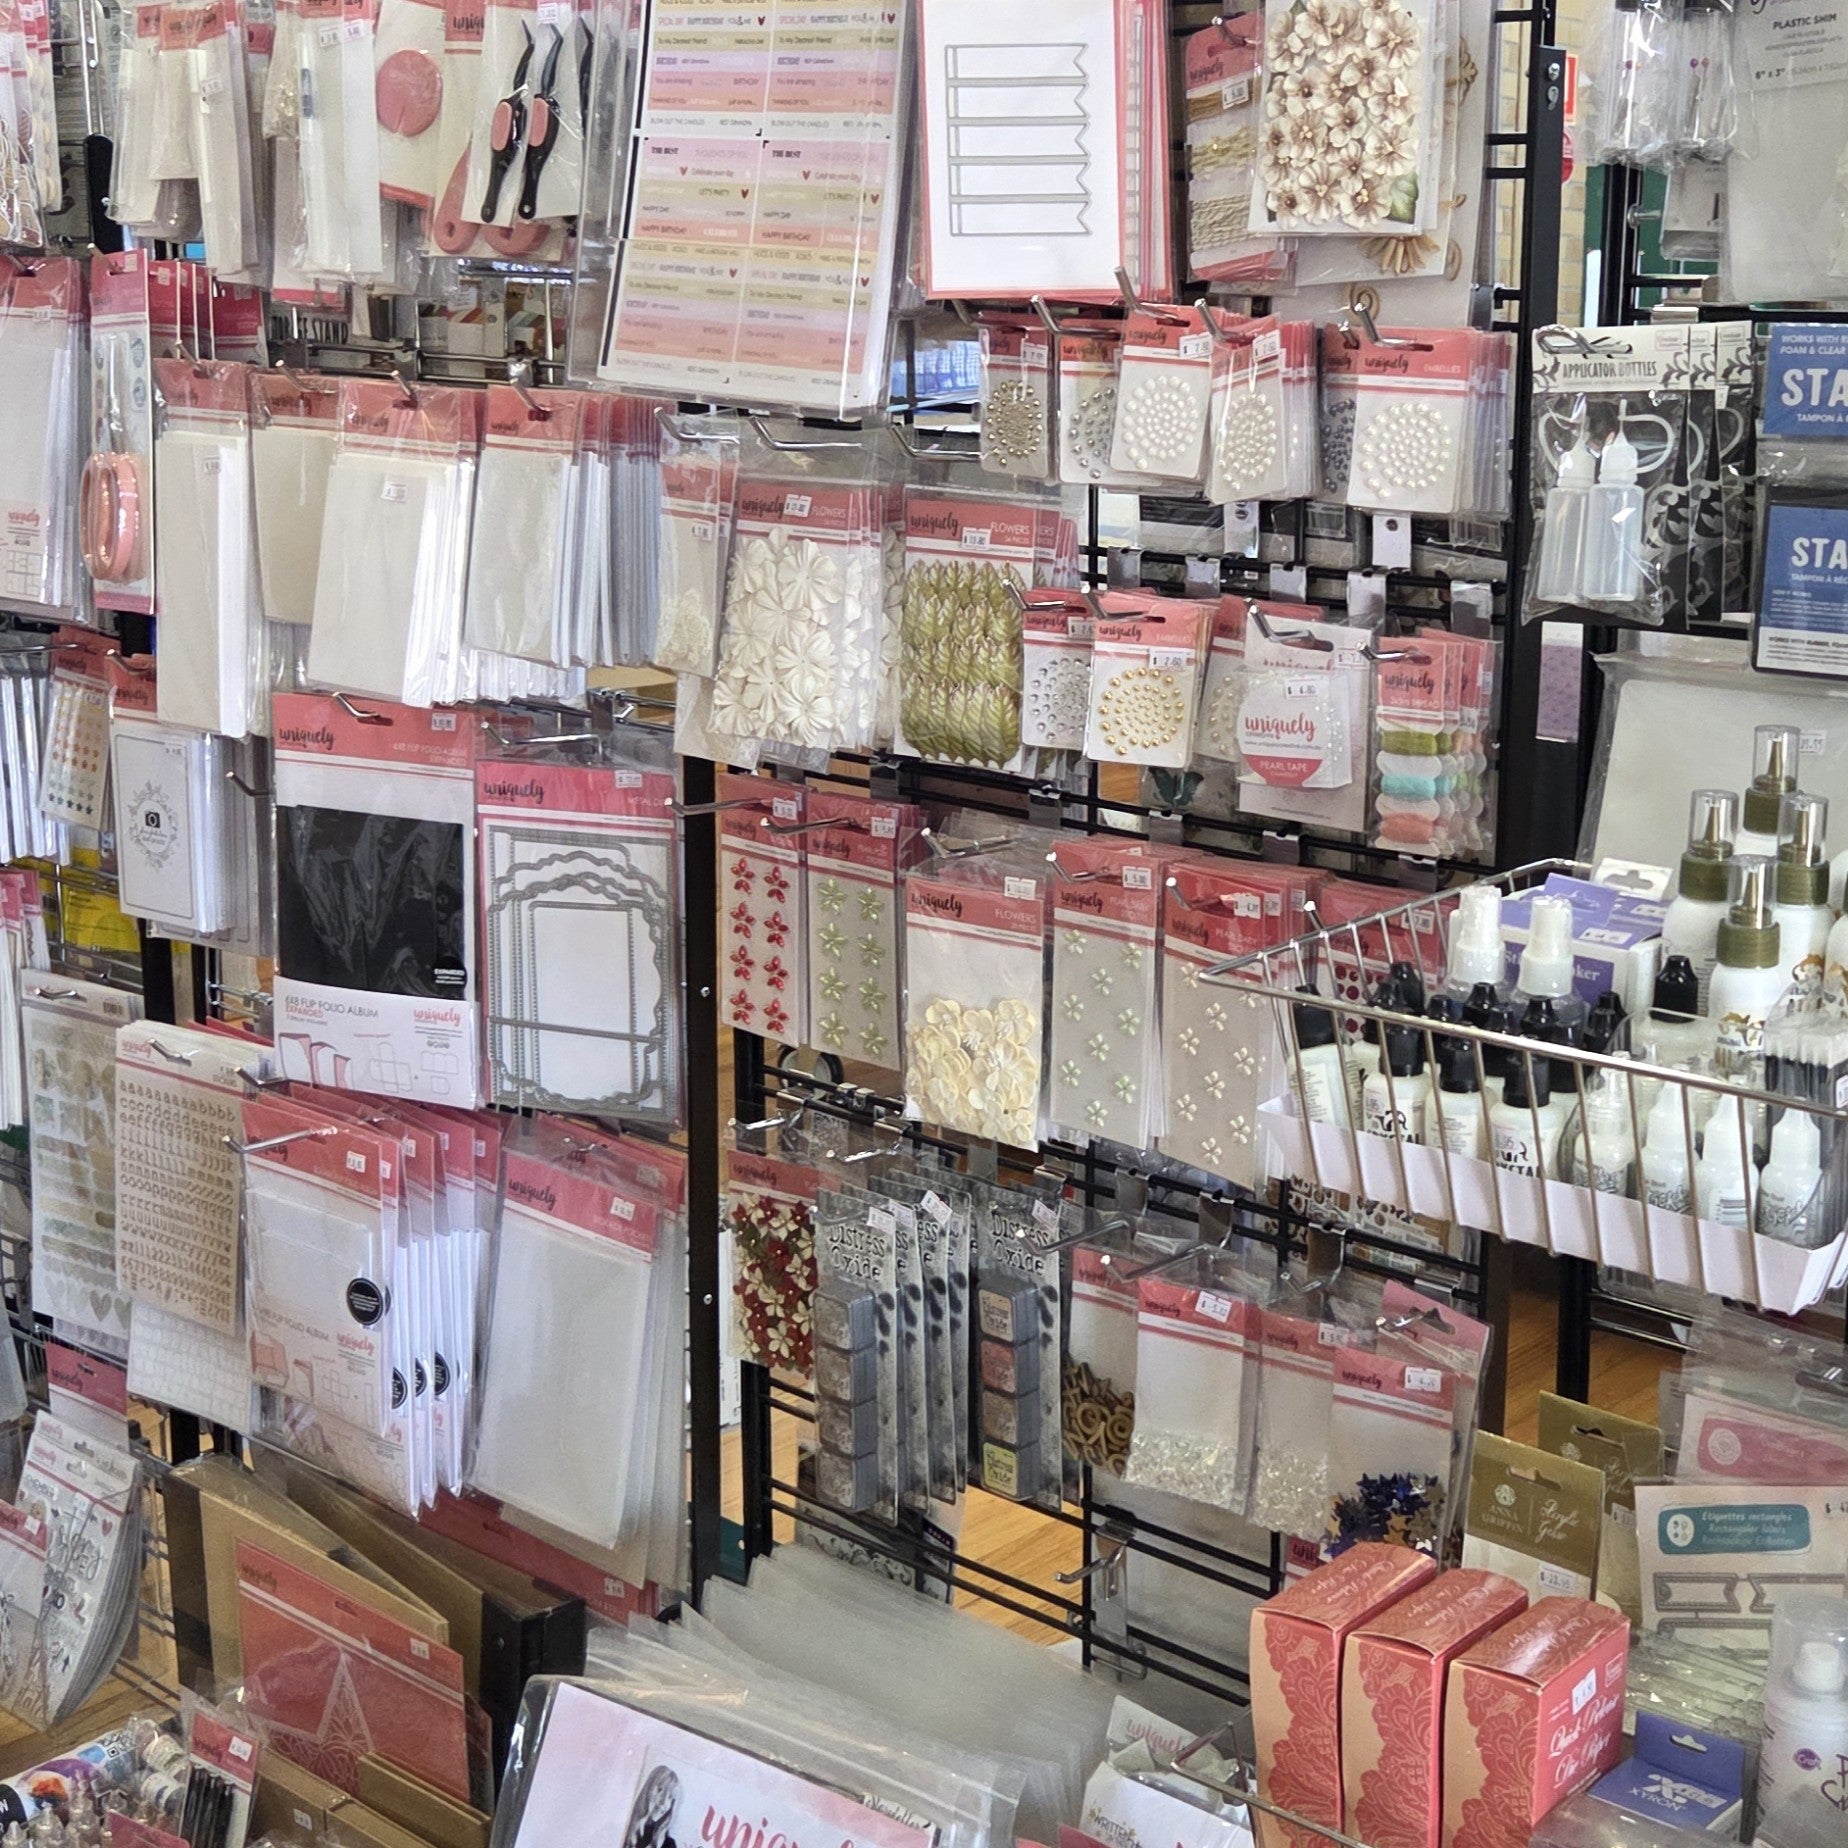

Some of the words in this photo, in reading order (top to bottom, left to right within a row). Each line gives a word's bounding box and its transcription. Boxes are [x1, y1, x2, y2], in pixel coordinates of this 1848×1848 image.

[1773, 16, 1811, 30] PLASTIC
[1814, 13, 1837, 24] SHIM
[663, 147, 678, 155] BEST
[785, 150, 801, 158] BEST
[1781, 335, 1814, 343] WORKS
[1816, 335, 1840, 343] WITH
[1780, 346, 1807, 355] FOAM
[1809, 346, 1816, 355] &
[1817, 346, 1847, 355] CLEAR
[1563, 362, 1616, 378] APPLICATOR
[1618, 361, 1657, 377] BOTTLES
[1781, 368, 1848, 407] STA
[1797, 413, 1835, 422] TAMPON
[910, 512, 959, 536] uniquely
[990, 522, 1030, 535] FLOWERS
[1791, 537, 1848, 570] STA
[1099, 624, 1142, 642] uniquely
[1385, 672, 1435, 695] uniquely
[1244, 712, 1317, 742] uniquely
[280, 727, 334, 751] uniquely
[1260, 761, 1286, 770] PEARL
[1287, 762, 1308, 773] TAPE
[484, 779, 544, 804] uniquely
[911, 893, 963, 918] uniquely
[1061, 890, 1104, 913] uniquely
[995, 909, 1037, 924] FLOWERS
[286, 1005, 324, 1018] EXPANDED
[301, 998, 316, 1008] FLIP
[318, 1001, 345, 1014] FOLIO
[347, 1005, 379, 1018] ALBUM
[413, 1007, 461, 1027] uniquely
[509, 1179, 556, 1212] uniquely
[831, 1245, 882, 1282] Oxide
[994, 1238, 1045, 1275] Oxide
[1489, 1504, 1519, 1522] ANNA
[1702, 1511, 1746, 1522] Etiquettes
[1749, 1511, 1793, 1522] rectangles
[1481, 1513, 1524, 1534] GRIFFIN
[1626, 1786, 1682, 1812] XYRON
